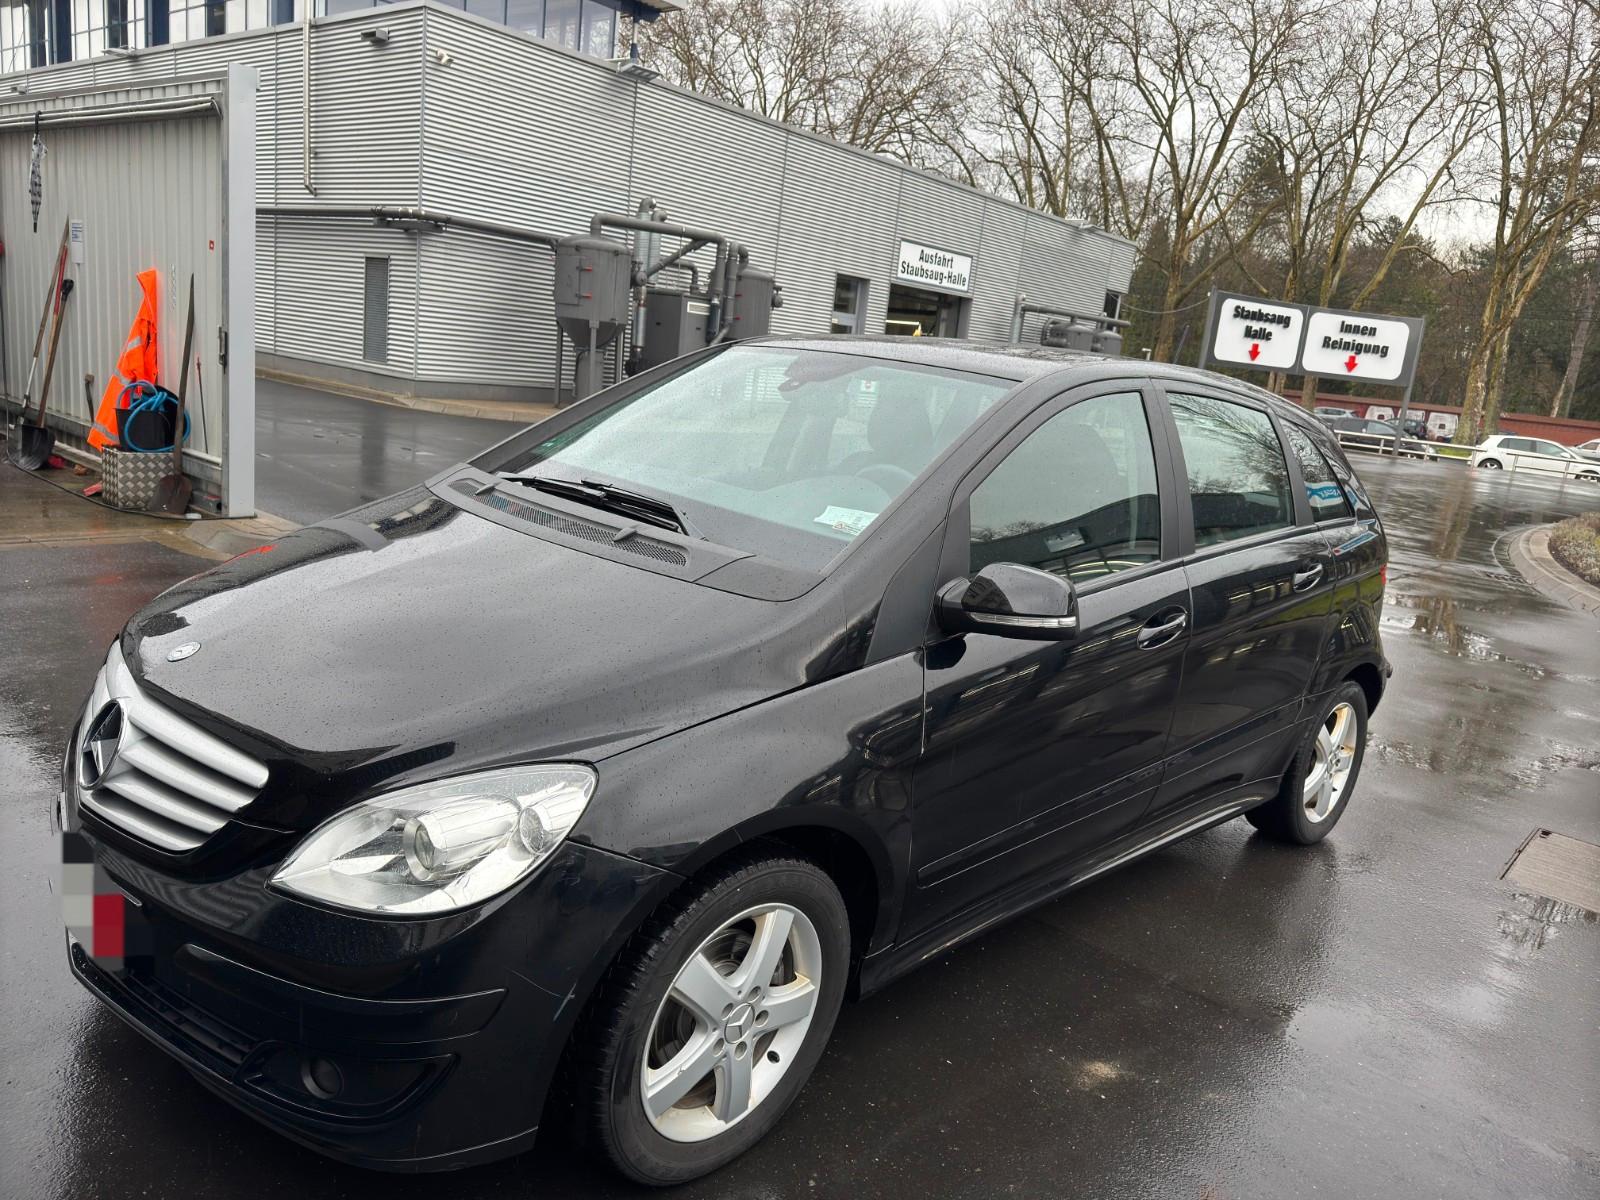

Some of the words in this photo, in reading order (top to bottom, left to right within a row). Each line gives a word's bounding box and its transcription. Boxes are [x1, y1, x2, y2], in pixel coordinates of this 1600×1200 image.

[919, 249, 954, 269] Ausfahrt
[901, 261, 967, 287] Staubsaug-Halle
[1233, 305, 1292, 329] Staubsaug
[1244, 325, 1273, 342] Halle
[1340, 320, 1377, 337] Innen
[1322, 335, 1390, 358] Reinigung
